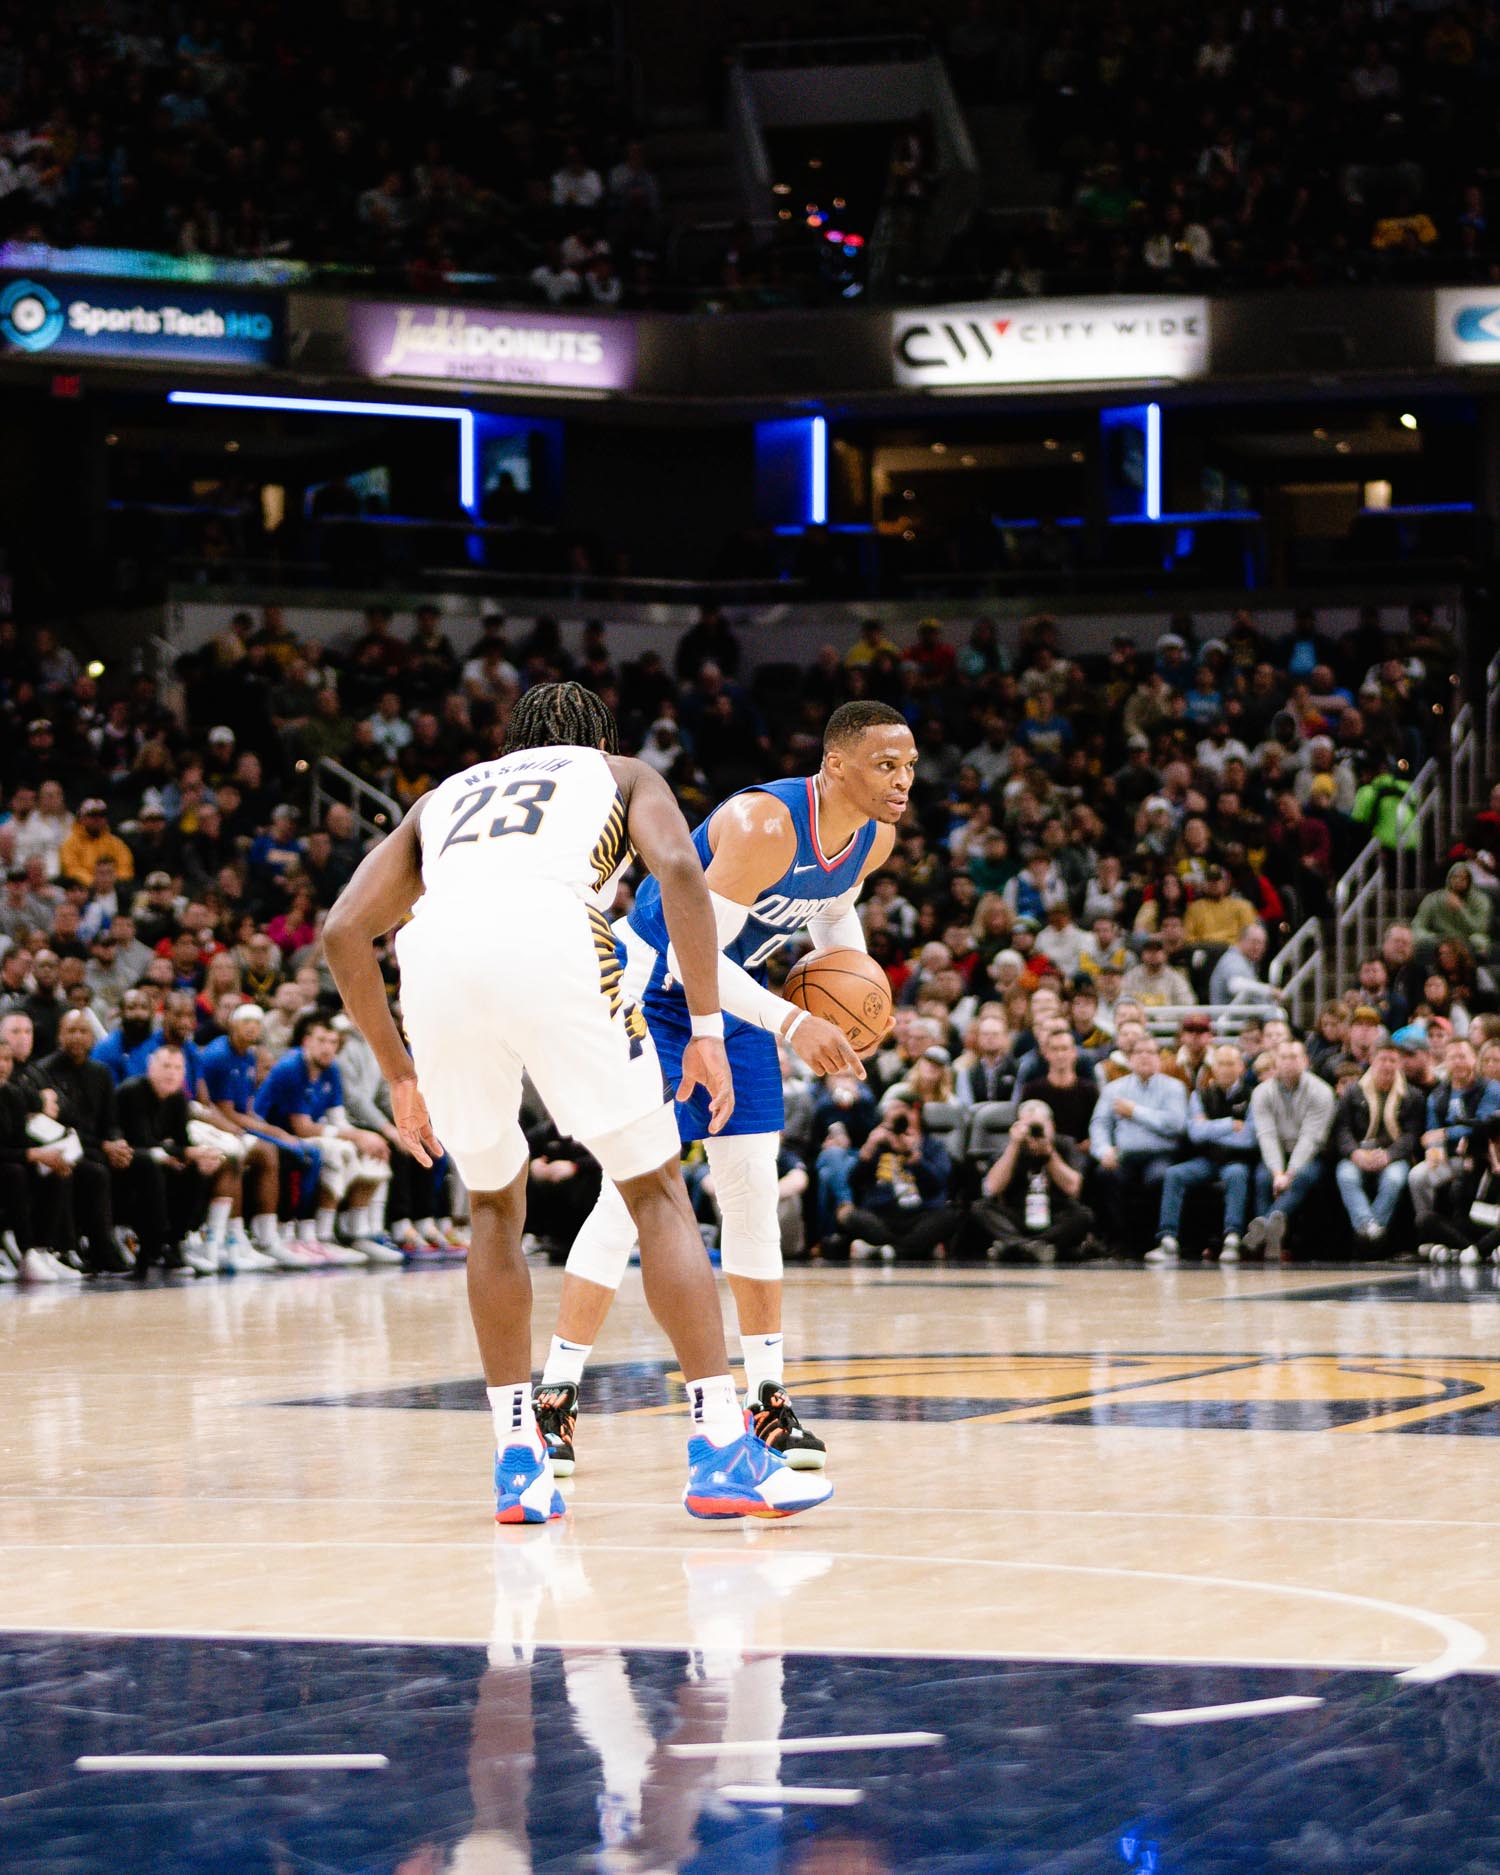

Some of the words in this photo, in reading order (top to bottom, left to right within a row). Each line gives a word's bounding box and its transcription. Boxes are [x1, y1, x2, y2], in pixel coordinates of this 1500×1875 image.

[465, 323, 604, 364] DONUTS
[1018, 320, 1095, 343] CITY
[1112, 315, 1200, 337] WIDE
[437, 779, 557, 857] 23
